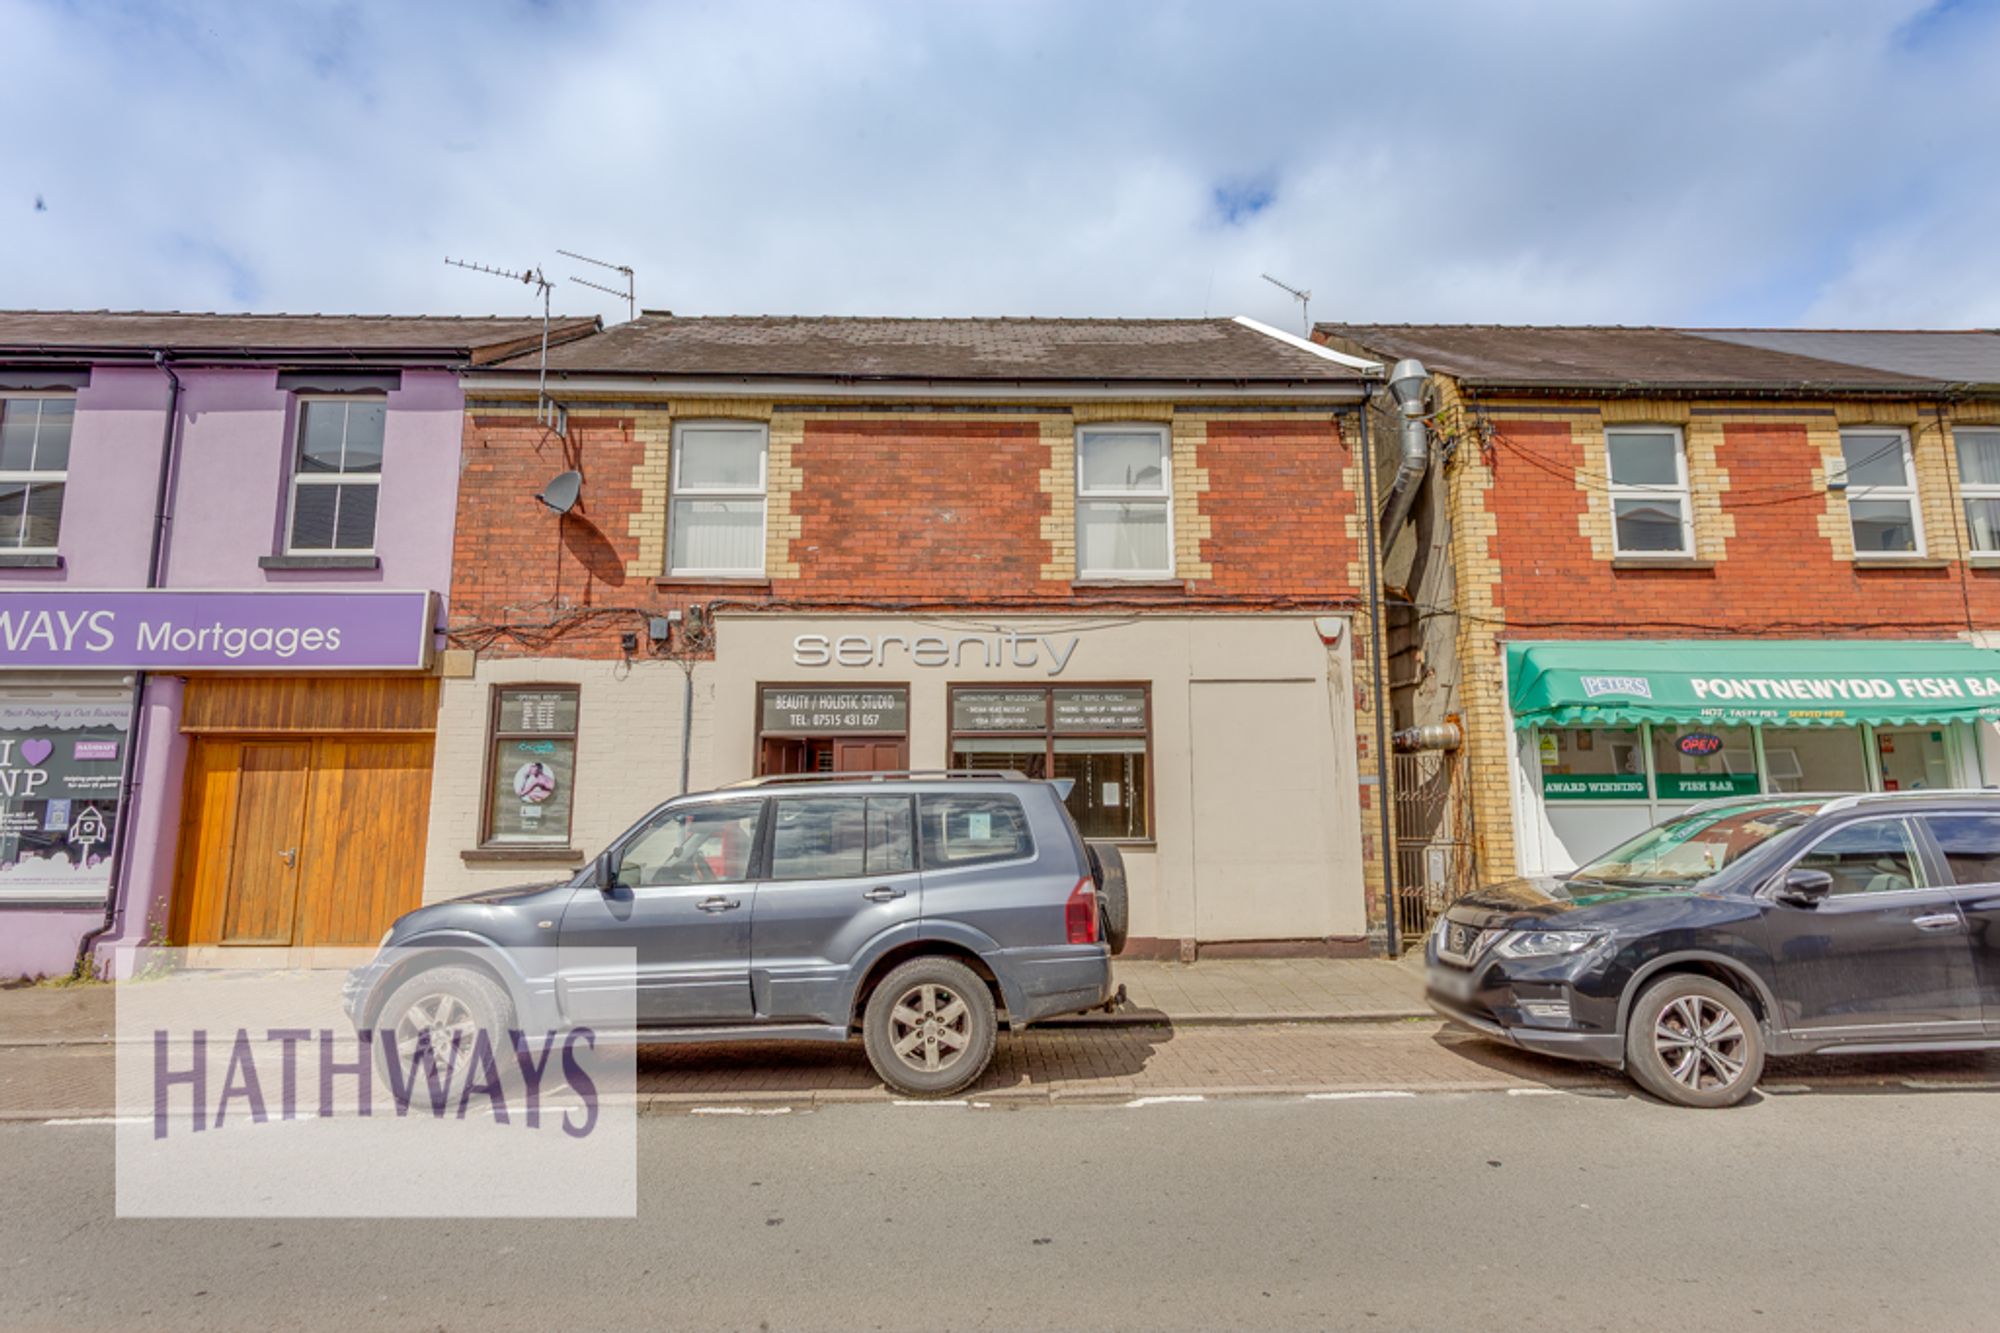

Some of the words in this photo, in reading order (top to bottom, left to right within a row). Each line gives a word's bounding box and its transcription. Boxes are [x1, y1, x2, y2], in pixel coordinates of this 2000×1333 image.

[136, 621, 341, 658] Mortgages
[793, 630, 1079, 677] serenity
[1690, 678, 1896, 699] PONTNEWYDD
[1896, 677, 1965, 698] FISH
[776, 694, 809, 710] BEAUTY
[819, 694, 859, 710] HOLISTIC
[861, 694, 895, 710] STUDIO
[812, 714, 841, 726] 07515
[843, 714, 860, 726] 431
[862, 714, 880, 726] 057
[1681, 738, 1719, 752] OPEN
[1545, 782, 1587, 792] AWARD
[1588, 783, 1645, 792] WINNING
[1678, 781, 1708, 792] FISH
[1709, 781, 1735, 792] BAR
